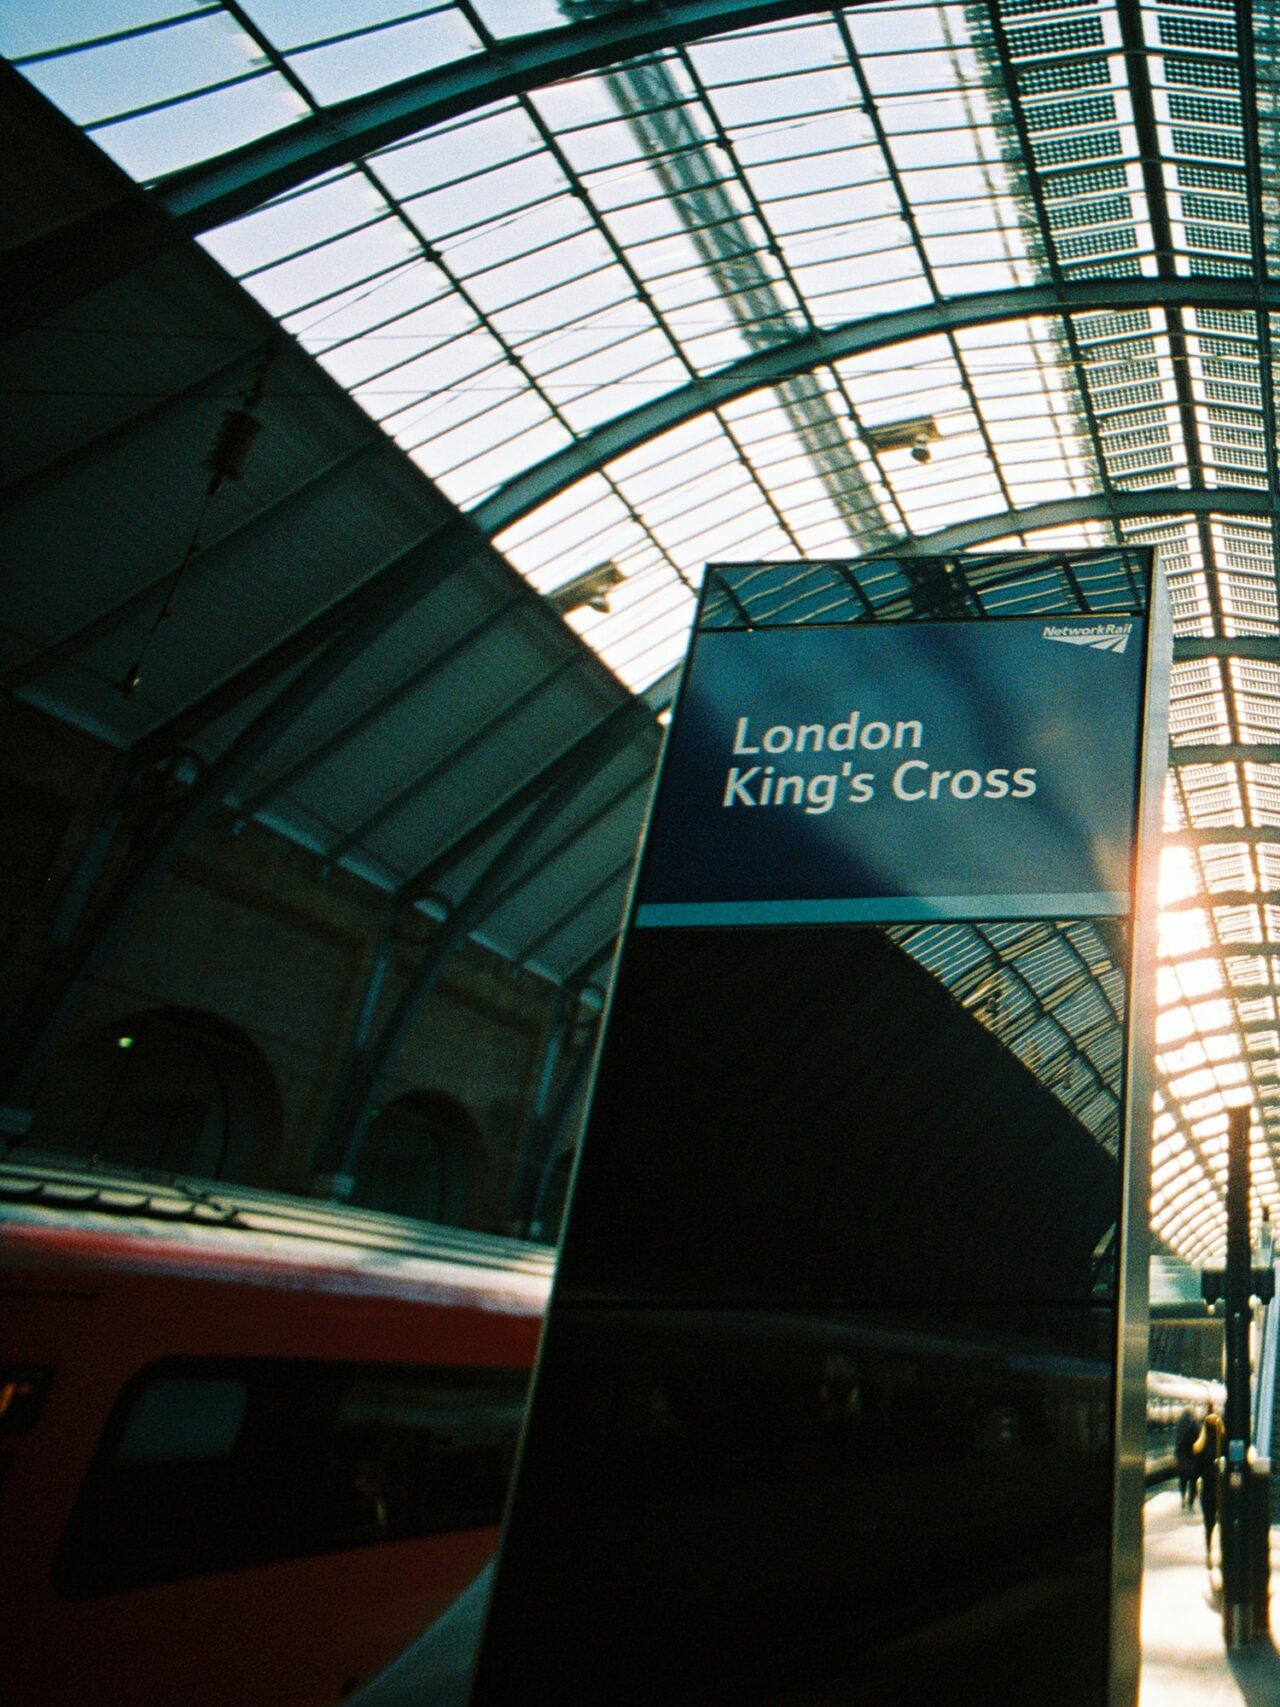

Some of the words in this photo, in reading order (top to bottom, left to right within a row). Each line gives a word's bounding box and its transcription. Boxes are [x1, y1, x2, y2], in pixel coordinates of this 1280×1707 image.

[732, 711, 923, 755] London
[723, 762, 874, 814] King's
[892, 760, 1037, 800] Cross
